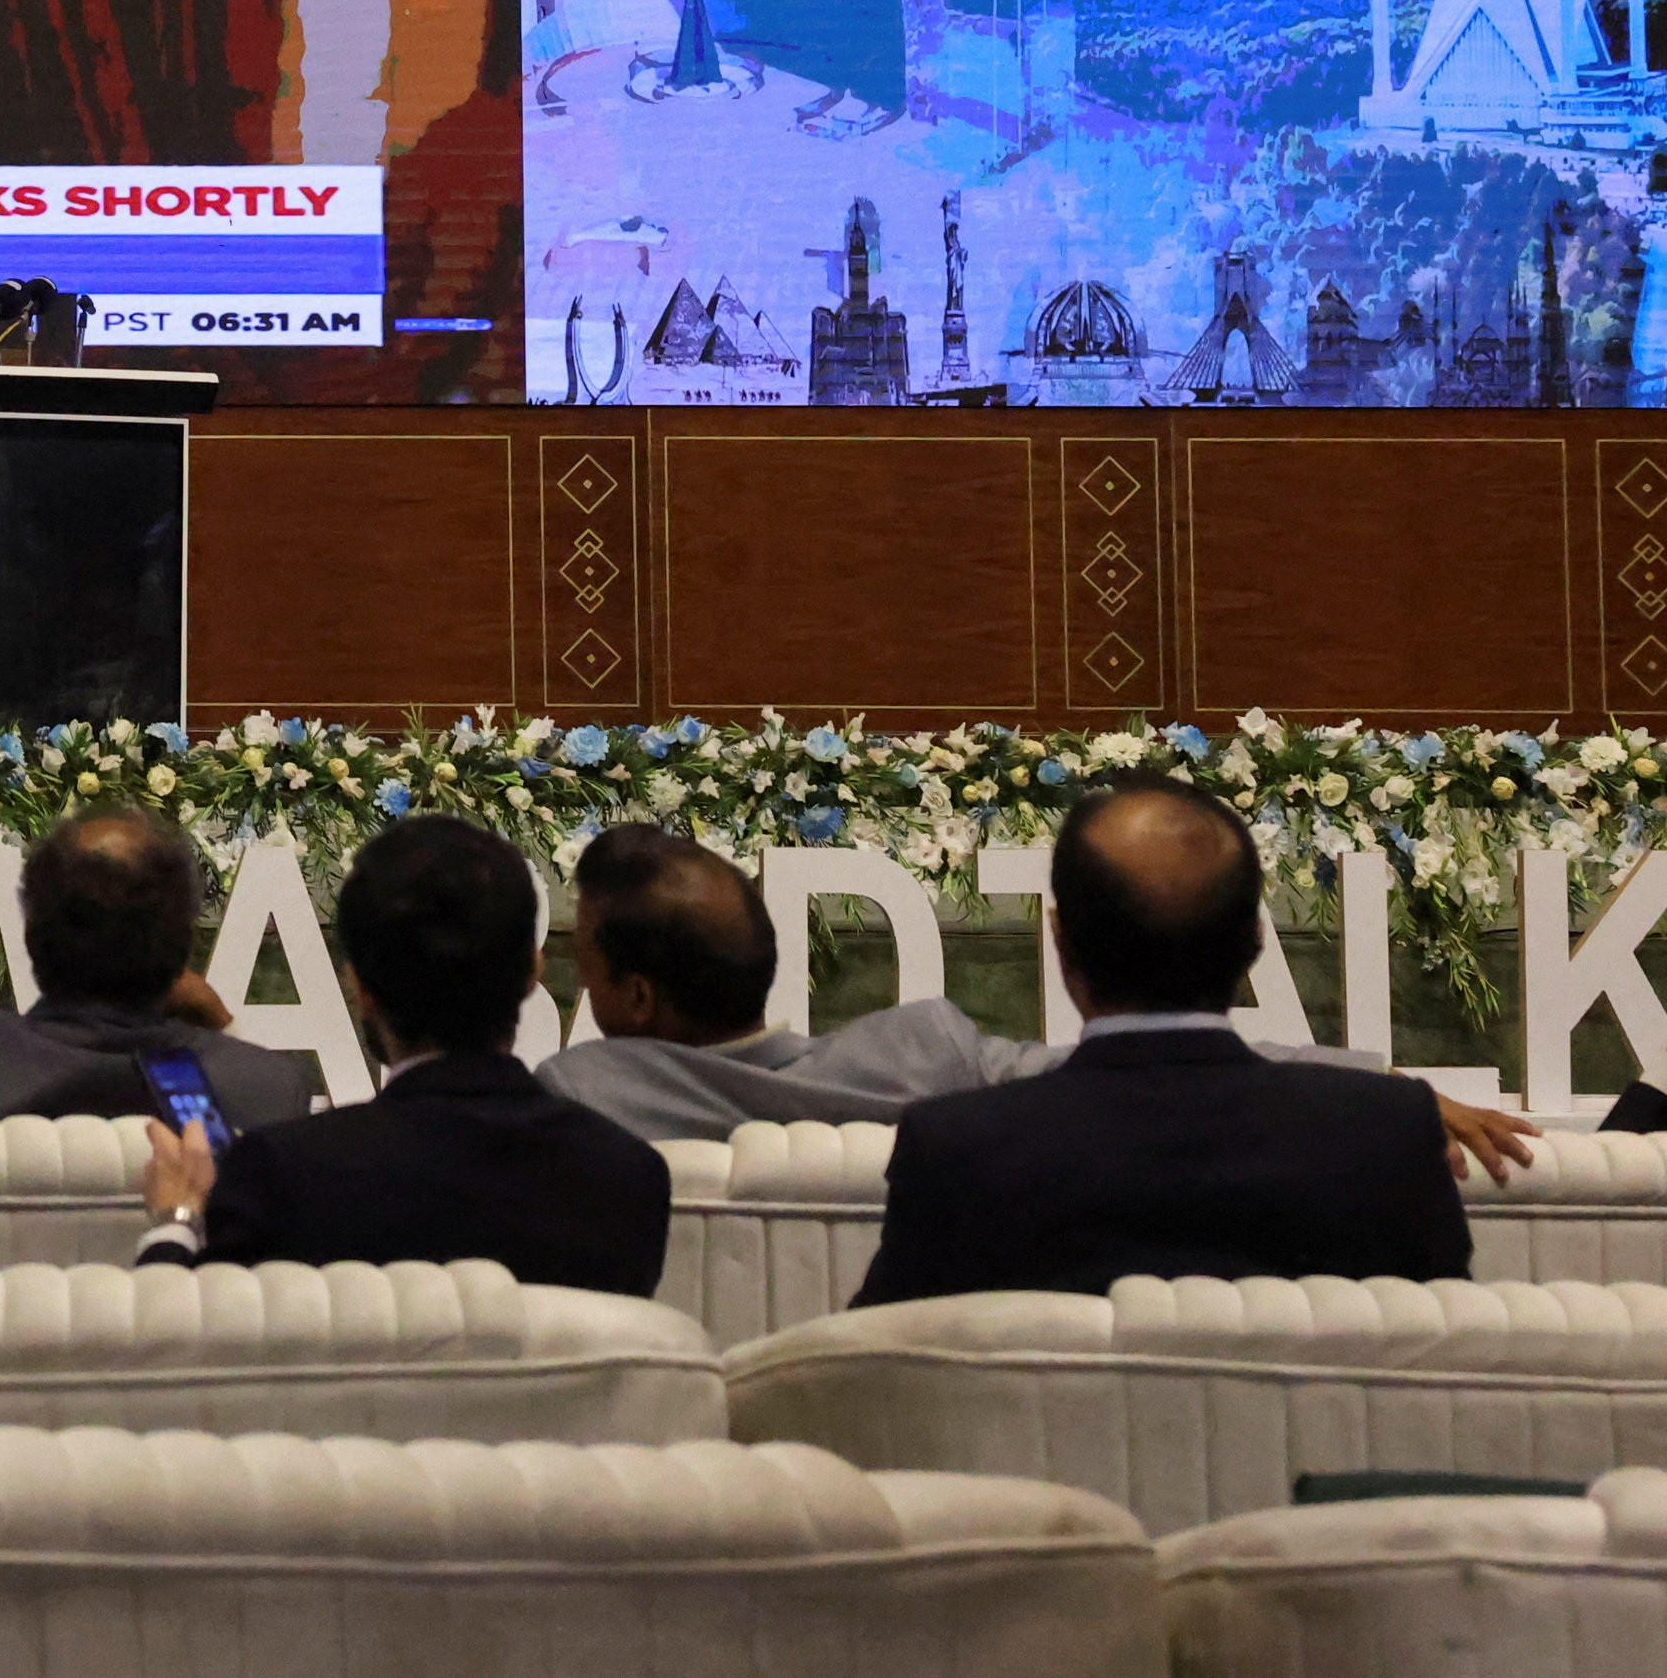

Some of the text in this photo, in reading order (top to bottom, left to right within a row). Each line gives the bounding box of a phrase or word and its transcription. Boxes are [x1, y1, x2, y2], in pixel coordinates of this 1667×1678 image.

[64, 185, 340, 218] SHORTLY
[104, 312, 362, 333] PST 06:31 AM
